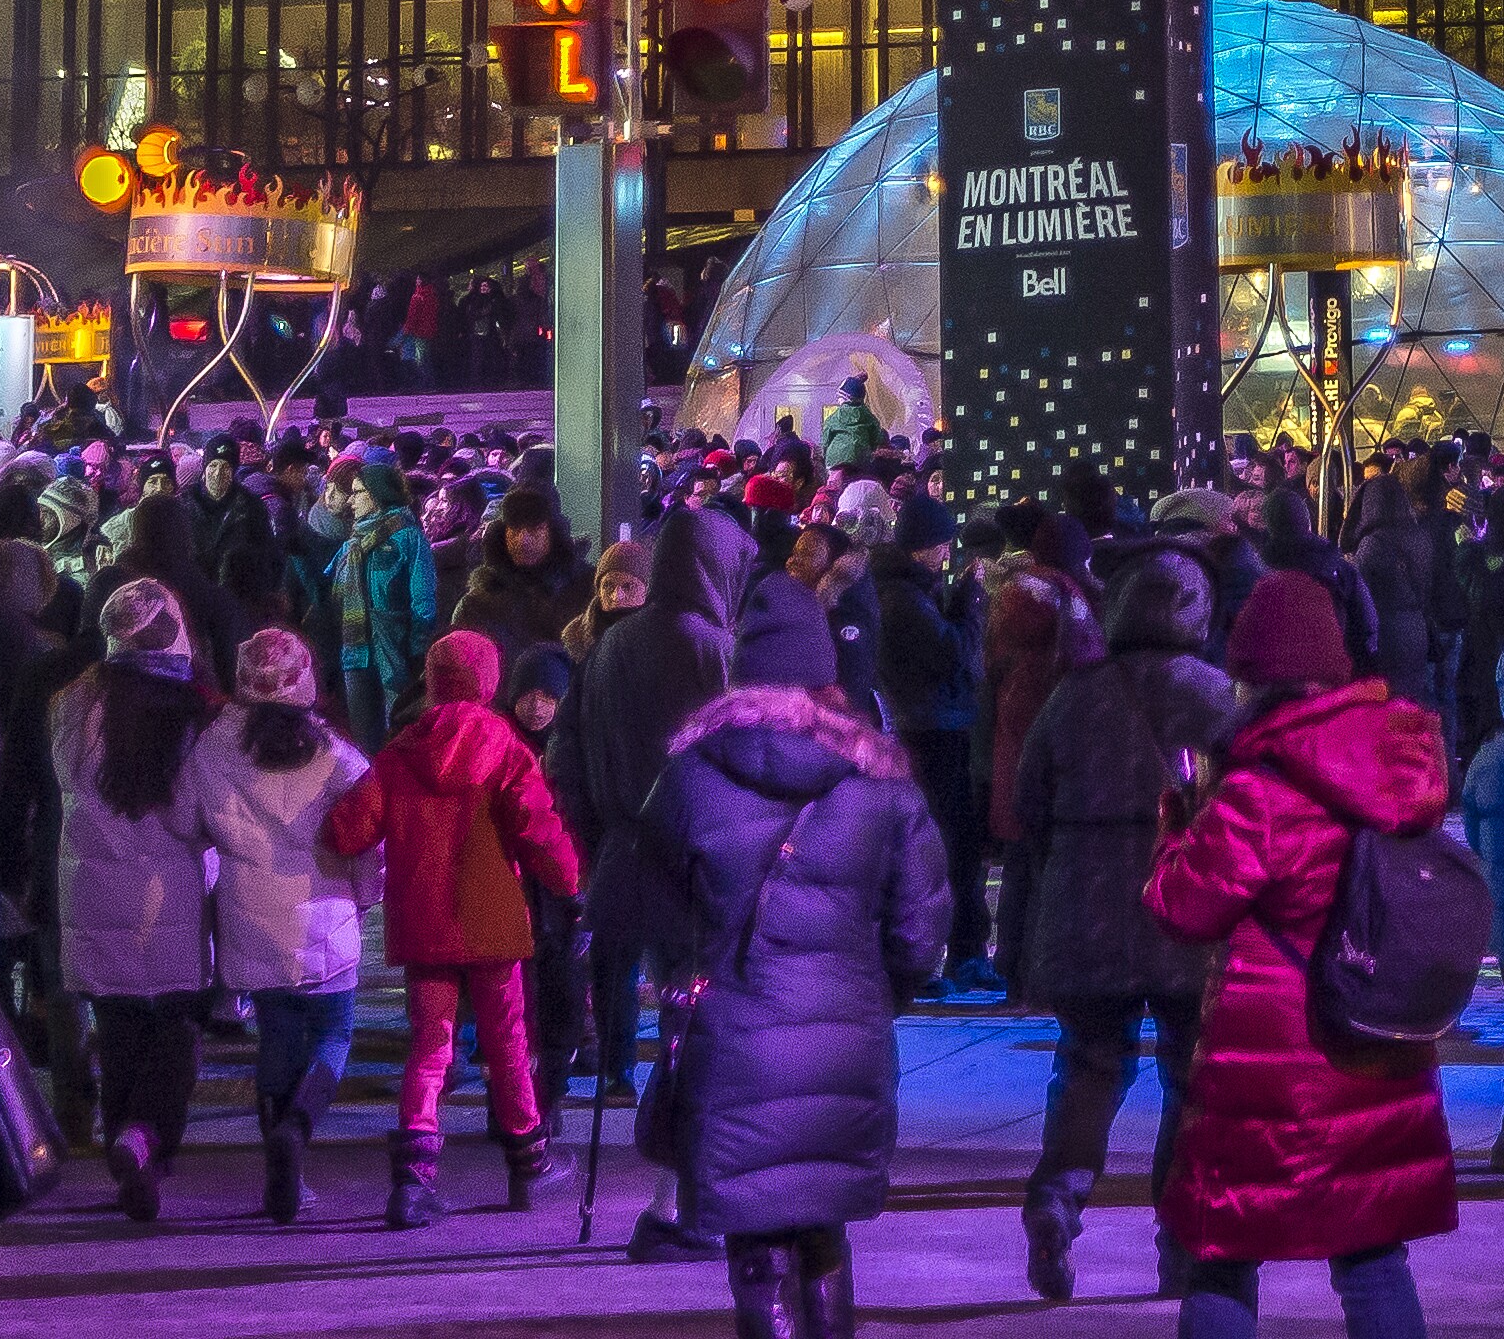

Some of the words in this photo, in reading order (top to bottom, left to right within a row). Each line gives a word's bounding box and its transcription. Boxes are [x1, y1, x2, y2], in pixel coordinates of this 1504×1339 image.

[1028, 124, 1058, 137] RBC
[962, 156, 1129, 209] MONTRÉAL
[195, 227, 254, 255] Sun
[957, 212, 993, 250] EN
[1002, 201, 1139, 246] LUMIÈRE
[1022, 266, 1067, 298] Bell
[1324, 297, 1342, 360] Provigo
